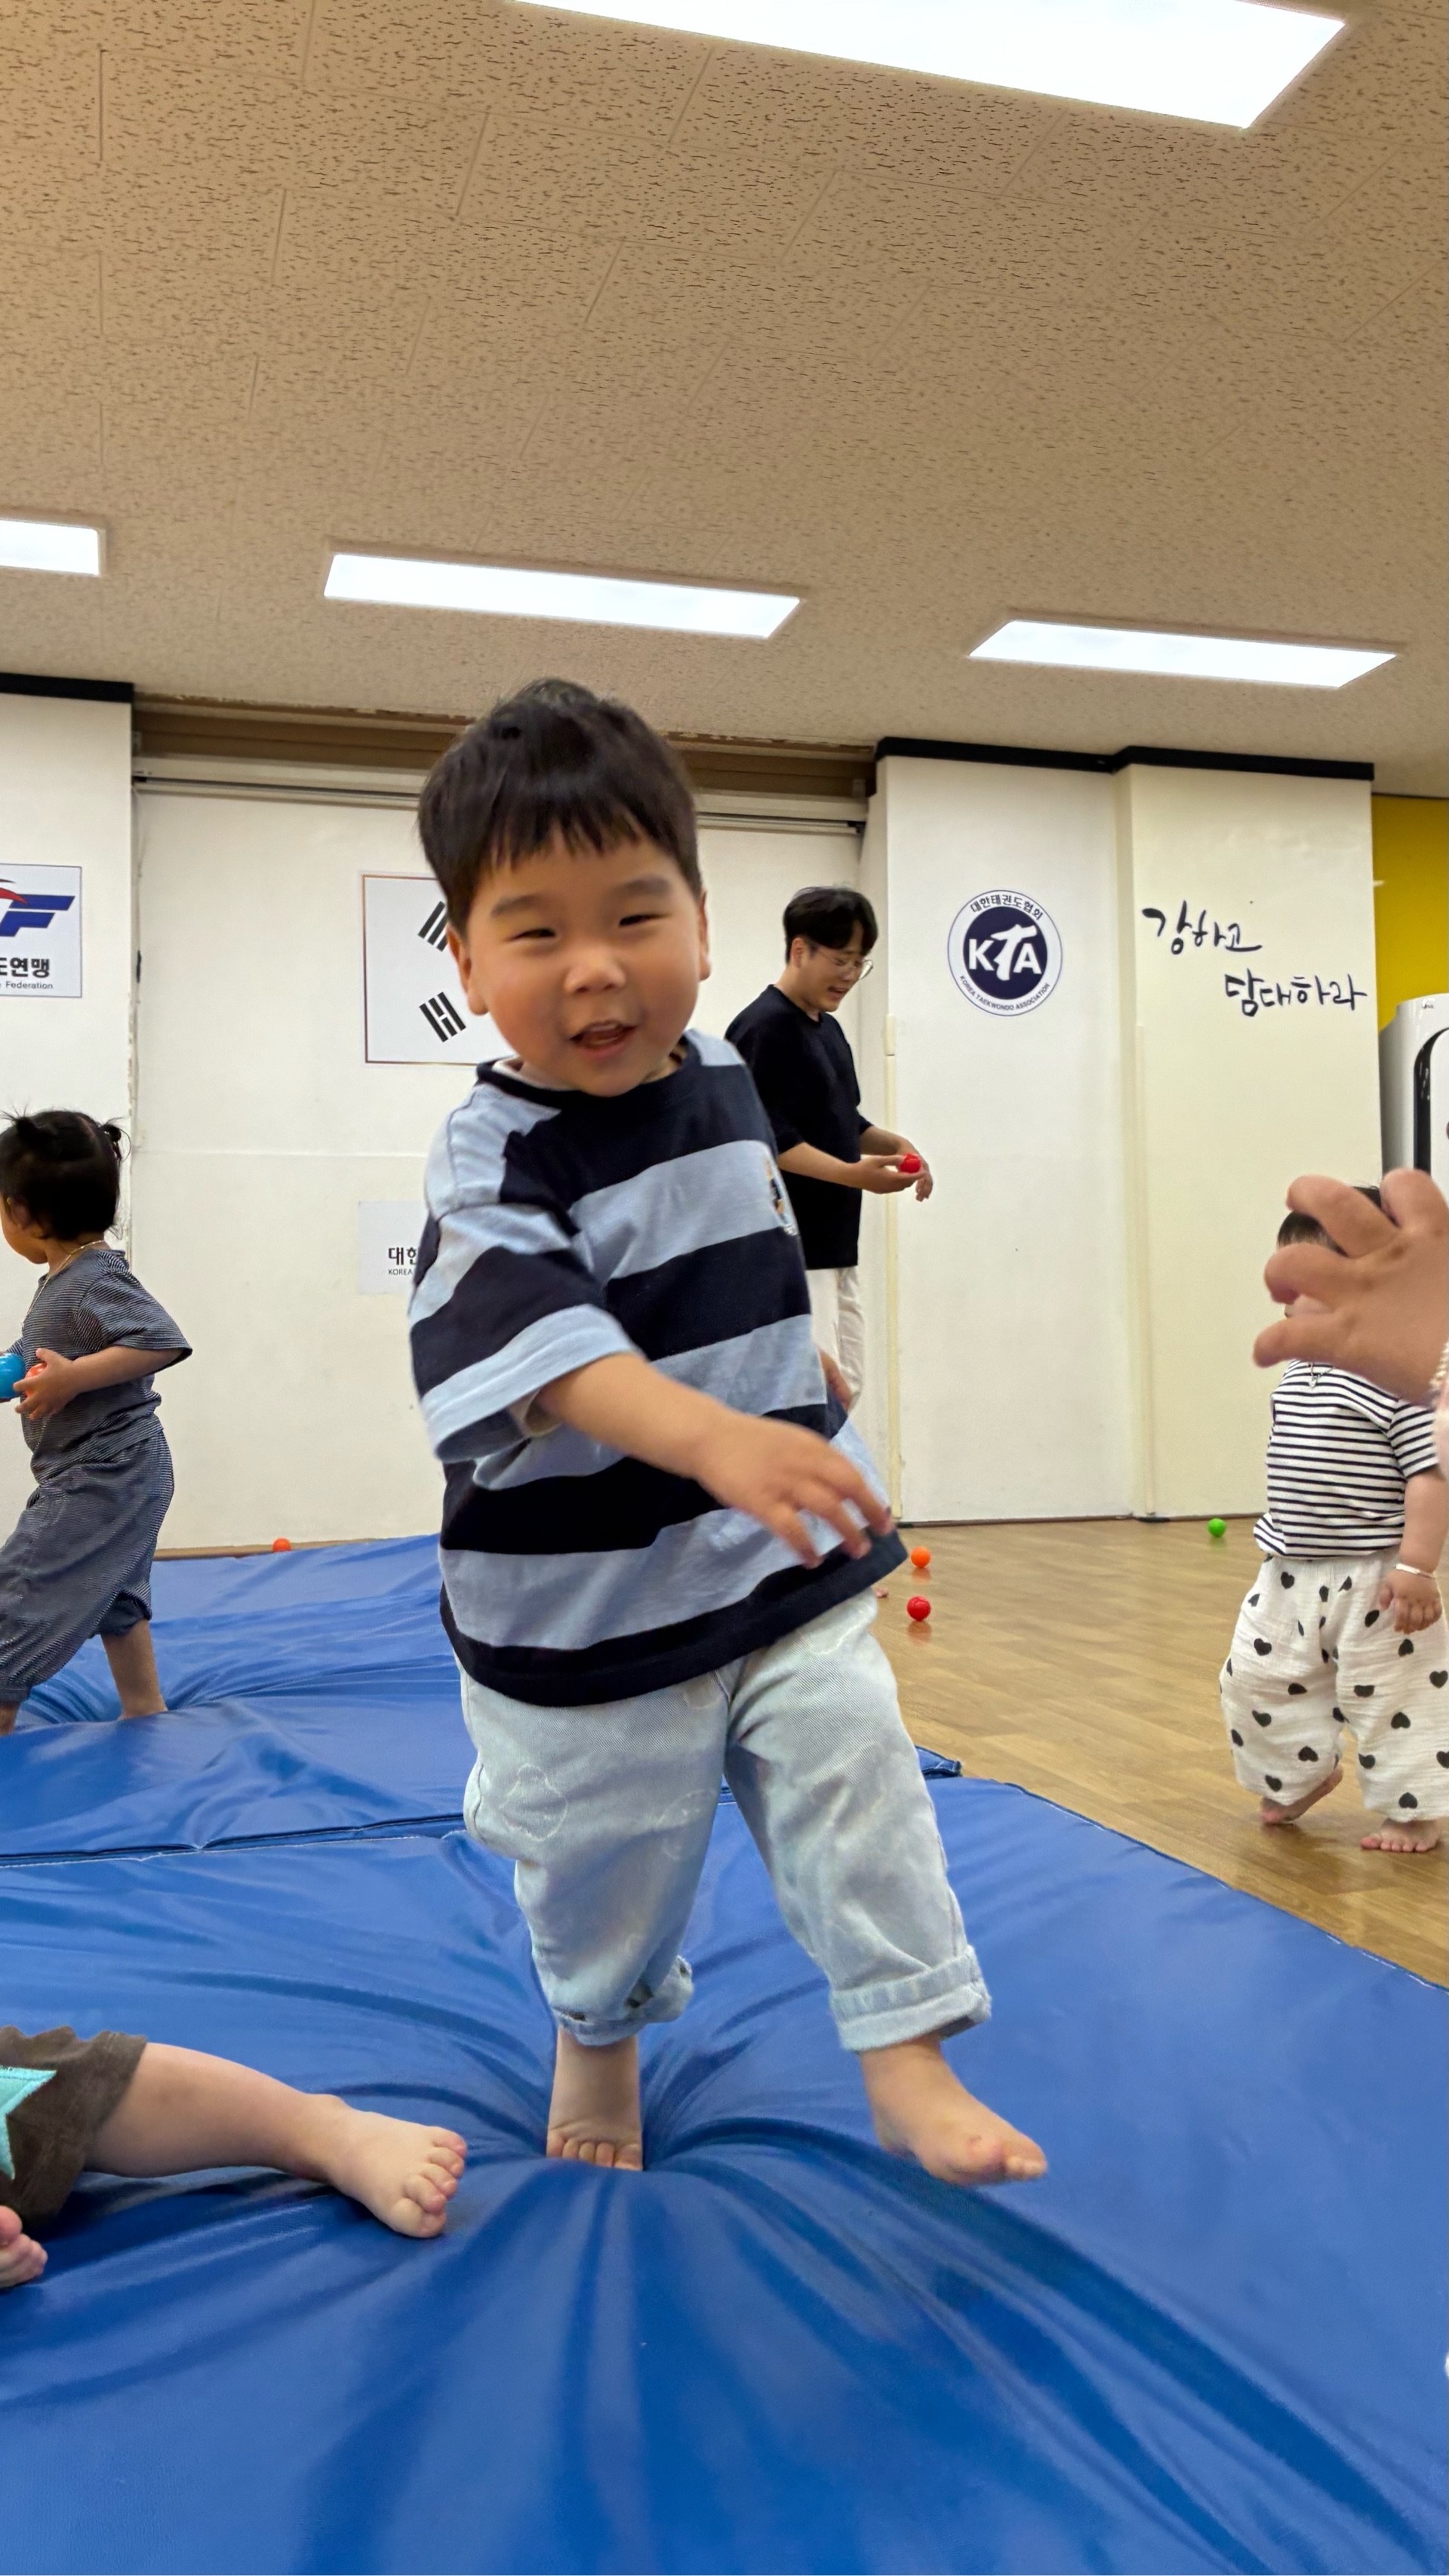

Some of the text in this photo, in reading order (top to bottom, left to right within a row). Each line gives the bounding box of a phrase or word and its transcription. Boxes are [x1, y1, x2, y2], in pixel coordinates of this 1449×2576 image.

[971, 894, 1044, 921] 대한태권도협회
[1142, 900, 1263, 954] 강하고
[969, 924, 1042, 981] KTA
[960, 975, 1051, 1010] KOREA TAEKWONDO ASSOCIATION
[1224, 968, 1367, 1017] 담대하라
